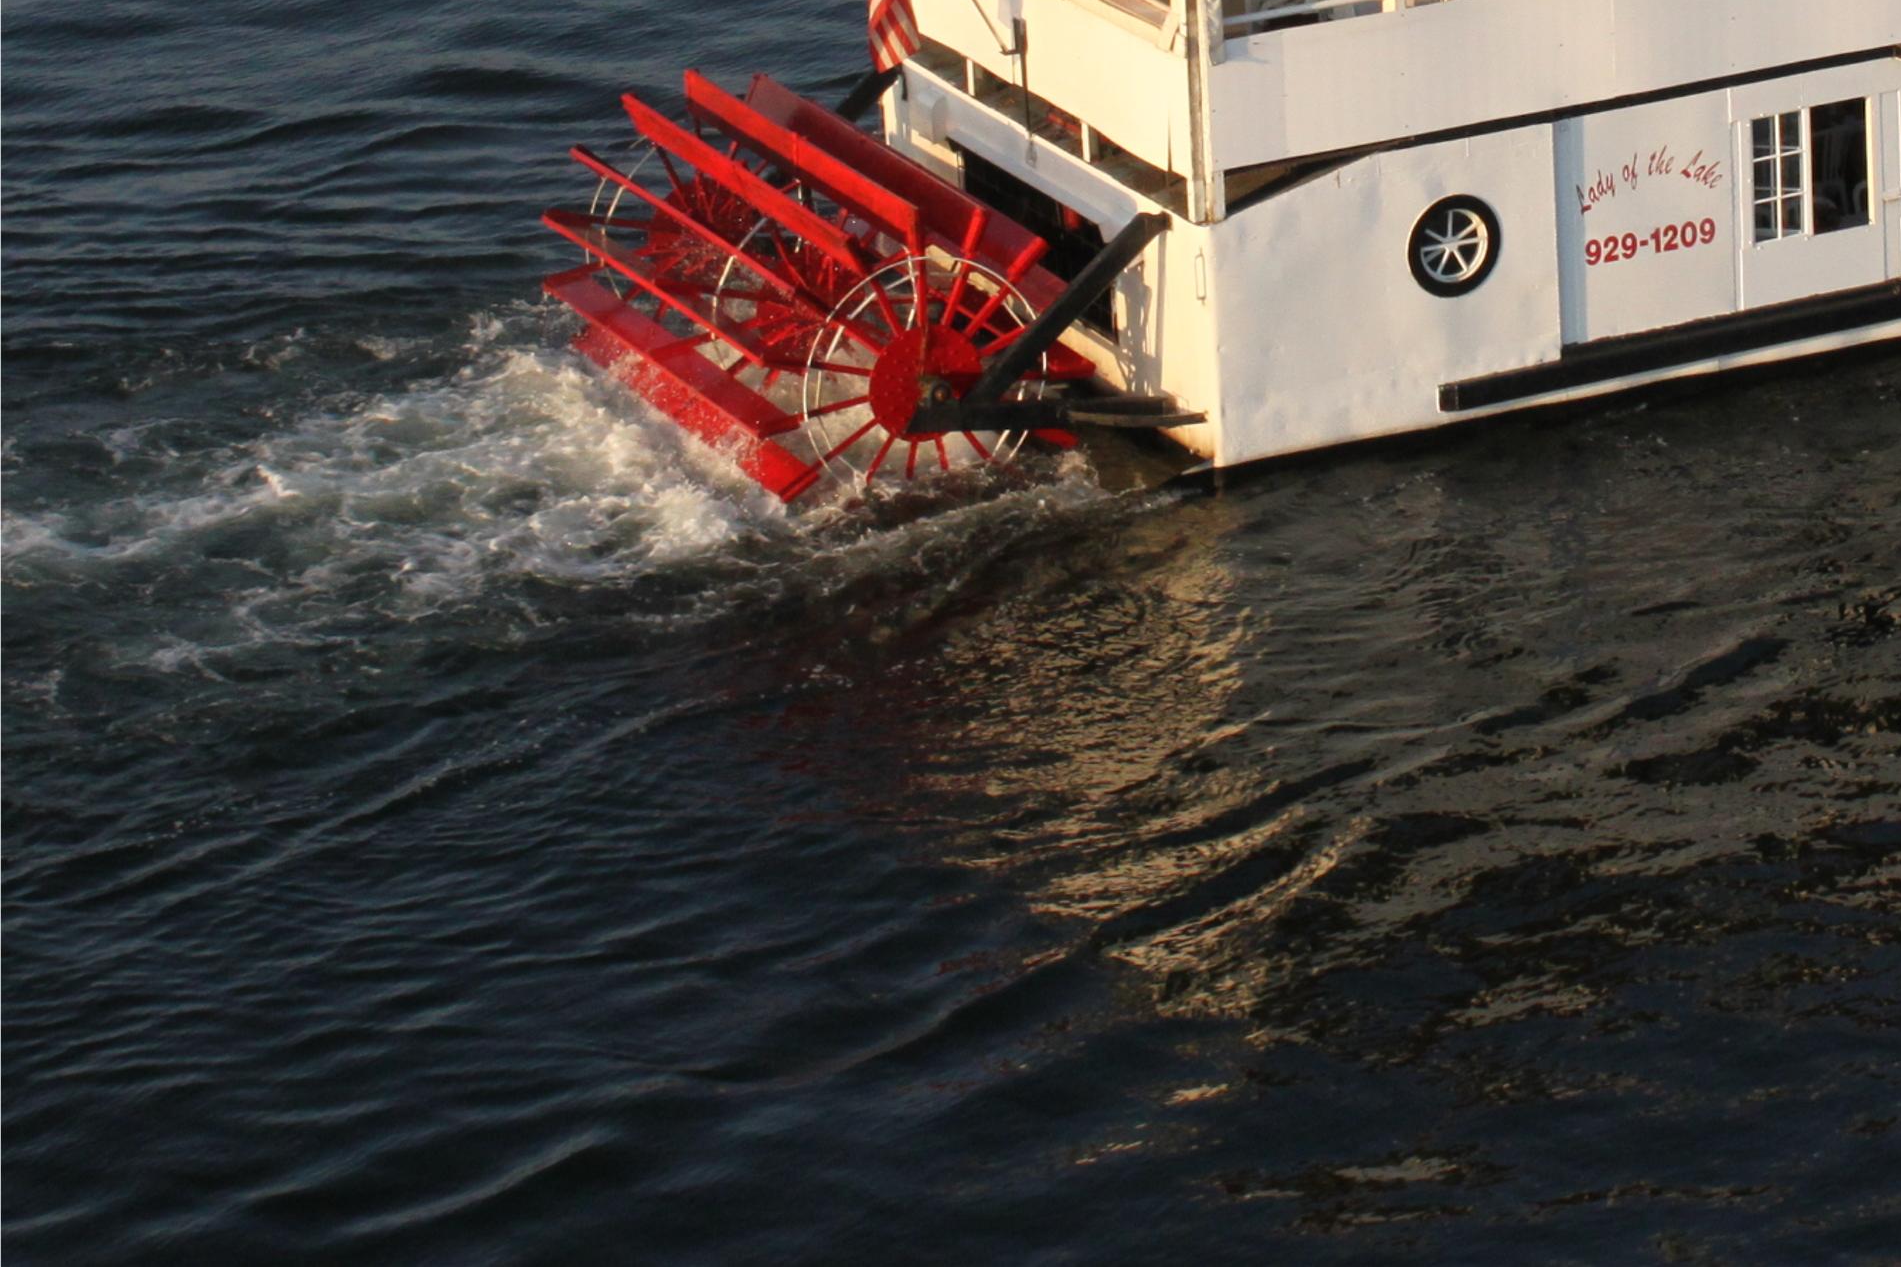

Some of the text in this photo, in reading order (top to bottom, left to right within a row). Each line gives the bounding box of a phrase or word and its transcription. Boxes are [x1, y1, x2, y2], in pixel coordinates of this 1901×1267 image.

[1576, 144, 1723, 215] Lady of the Lake
[1584, 217, 1716, 266] 929-1209
